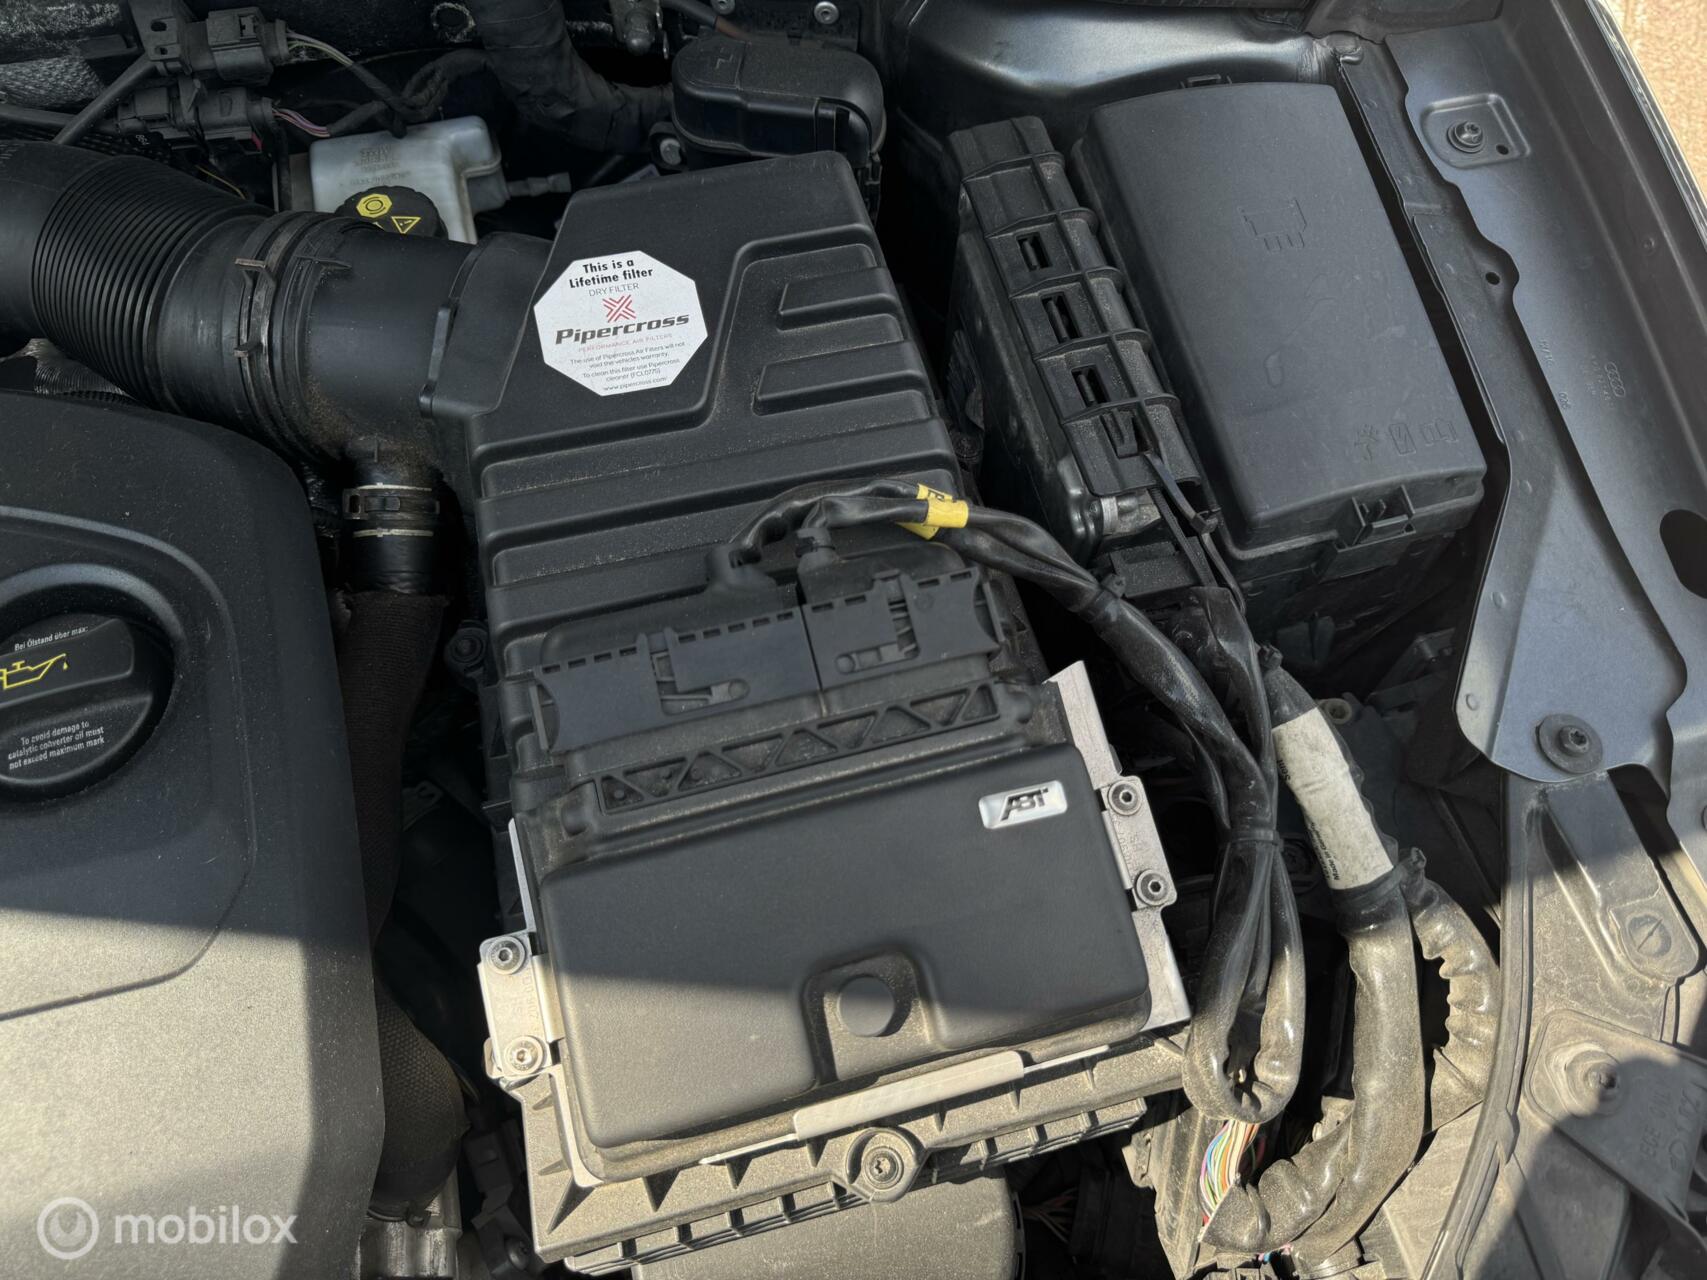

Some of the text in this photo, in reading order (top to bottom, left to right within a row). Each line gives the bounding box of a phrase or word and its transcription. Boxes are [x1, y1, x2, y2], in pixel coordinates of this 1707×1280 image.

[583, 262, 608, 274] This
[612, 260, 622, 269] is
[569, 268, 654, 288] Lifetime filter
[588, 282, 640, 297] DRY FILTER
[555, 314, 690, 345] Pipercross
[579, 340, 630, 352] PERFORMANCE
[602, 351, 636, 362] Pipercross
[616, 356, 640, 365] vehicles
[622, 365, 636, 373] filter
[648, 358, 680, 369] Pipercross
[14, 643, 26, 651] Bei
[27, 634, 53, 648] Ölstand
[54, 631, 70, 640] über
[8, 726, 104, 760] catalytic converter oil must
[21, 736, 30, 746] To
[32, 730, 50, 743] avoid
[52, 724, 80, 738] damage
[10, 736, 105, 770] not exceed maximum mark
[1000, 788, 1049, 821] ABT
